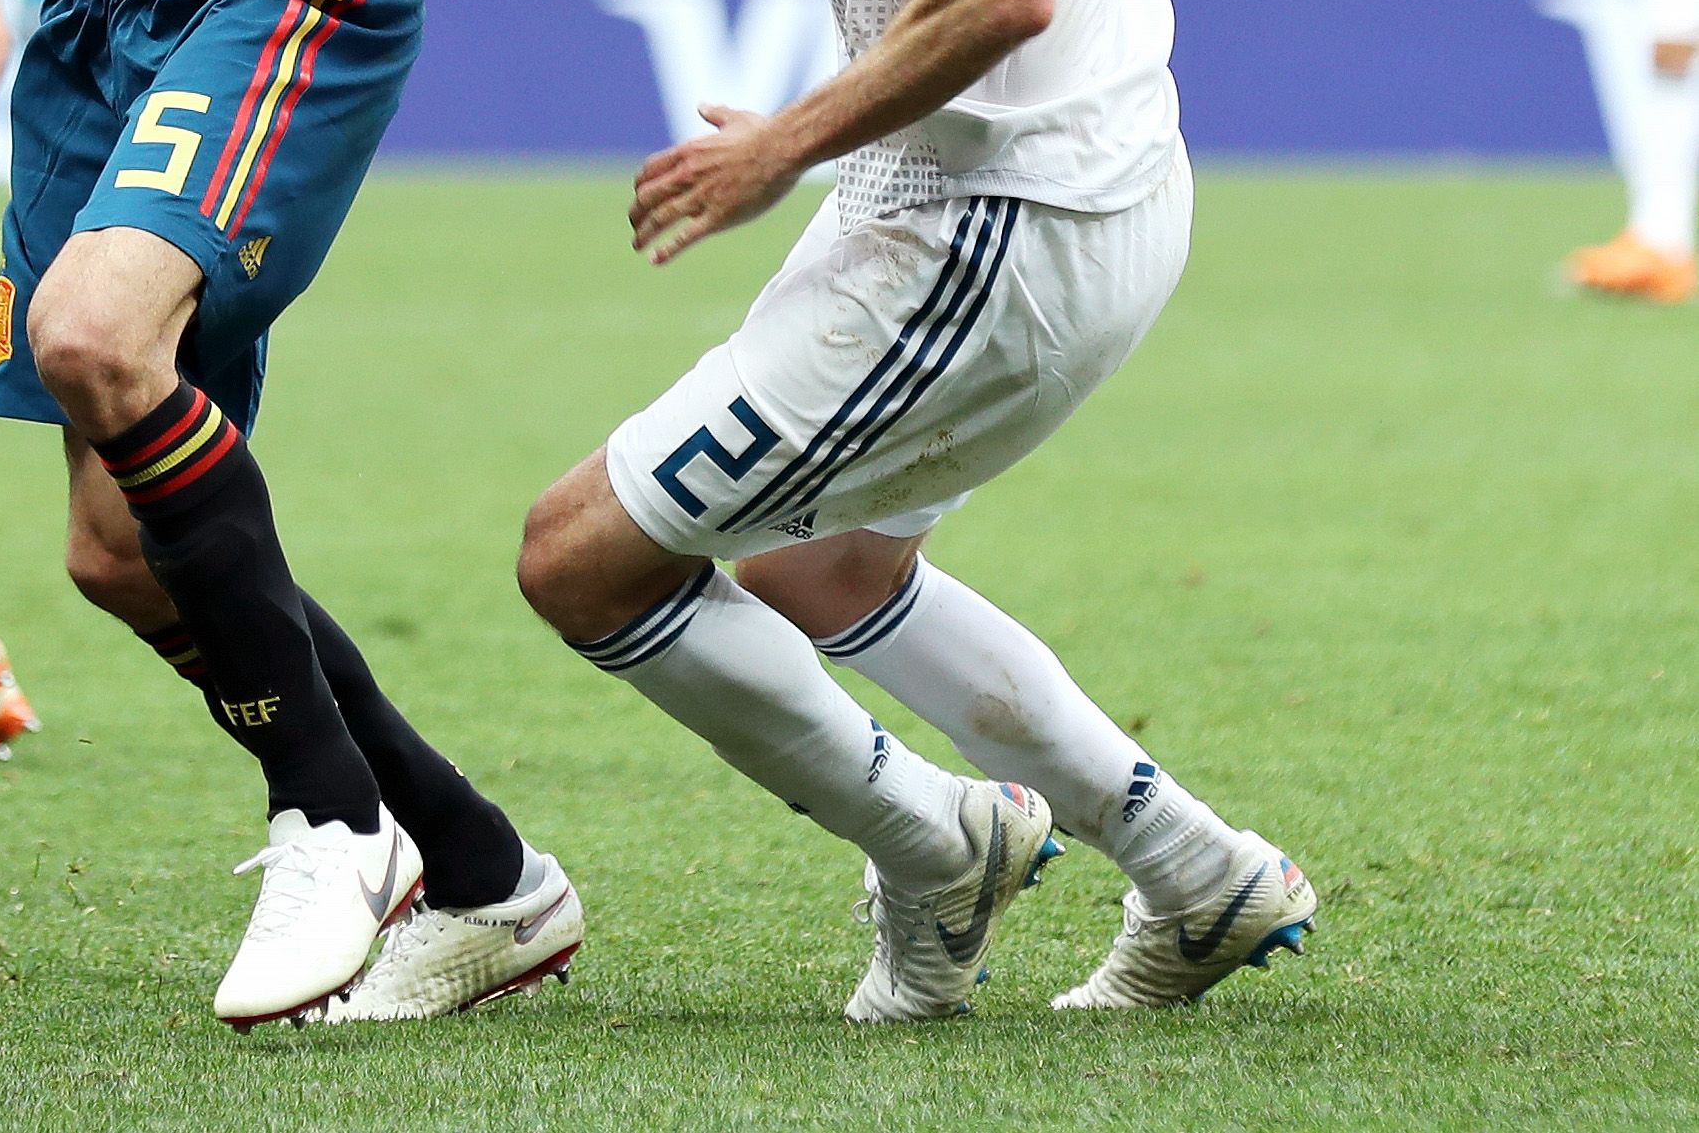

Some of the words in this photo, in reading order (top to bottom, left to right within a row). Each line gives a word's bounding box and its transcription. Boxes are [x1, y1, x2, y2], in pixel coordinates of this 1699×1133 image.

[113, 90, 212, 197] 5
[651, 394, 783, 521] 2
[220, 696, 281, 727] FEF
